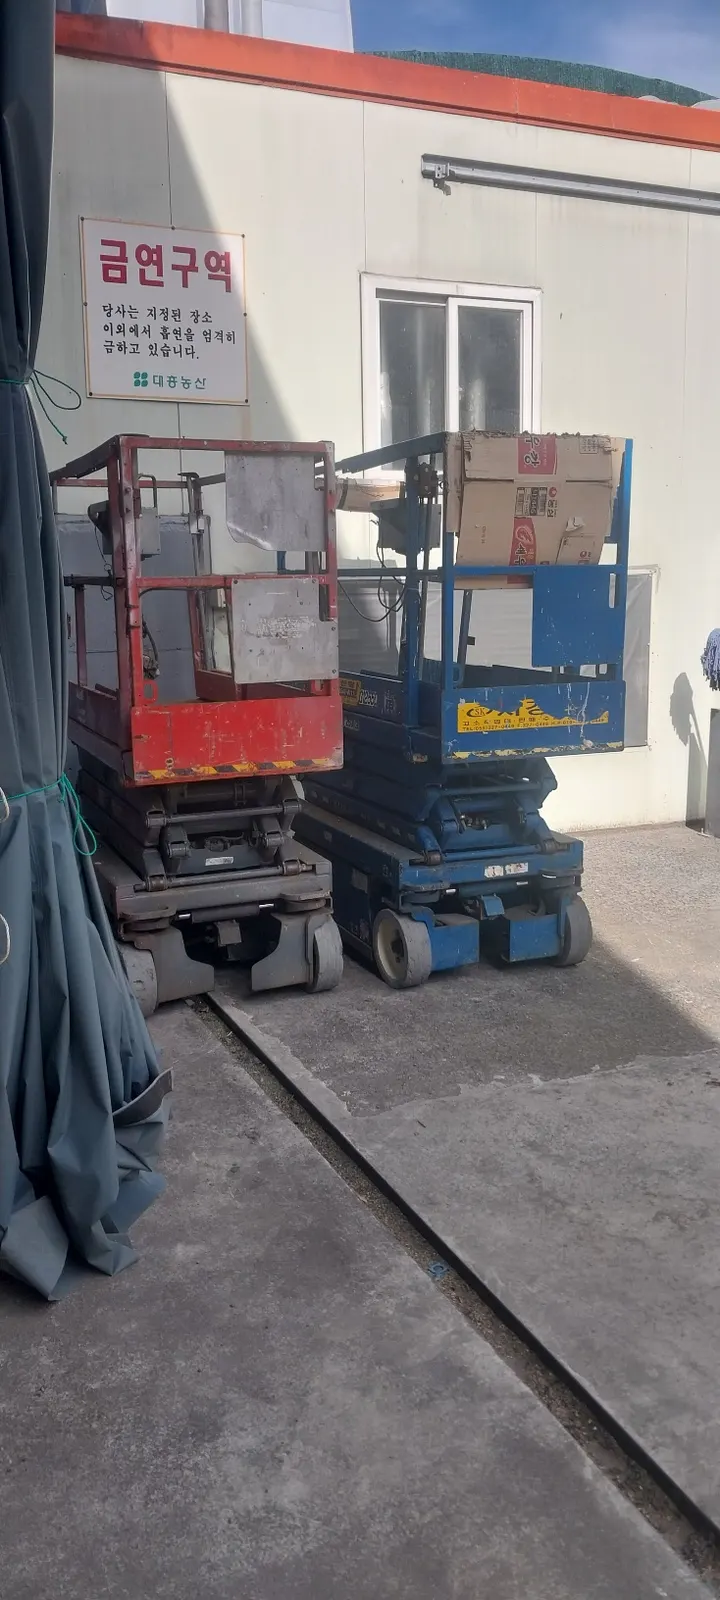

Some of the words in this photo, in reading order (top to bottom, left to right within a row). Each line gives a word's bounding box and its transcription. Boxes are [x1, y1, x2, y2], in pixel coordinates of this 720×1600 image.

[100, 239, 231, 293] 금연구역
[102, 303, 139, 320] 당사는
[146, 307, 182, 323] 지정된
[190, 310, 213, 324] 장소
[103, 323, 151, 339] 이외에서
[160, 325, 195, 342] 흡연을
[202, 329, 236, 345] 엄격히
[103, 340, 141, 355] 금하고
[148, 343, 199, 360] 있습니다.
[152, 374, 207, 390] 대흥농산
